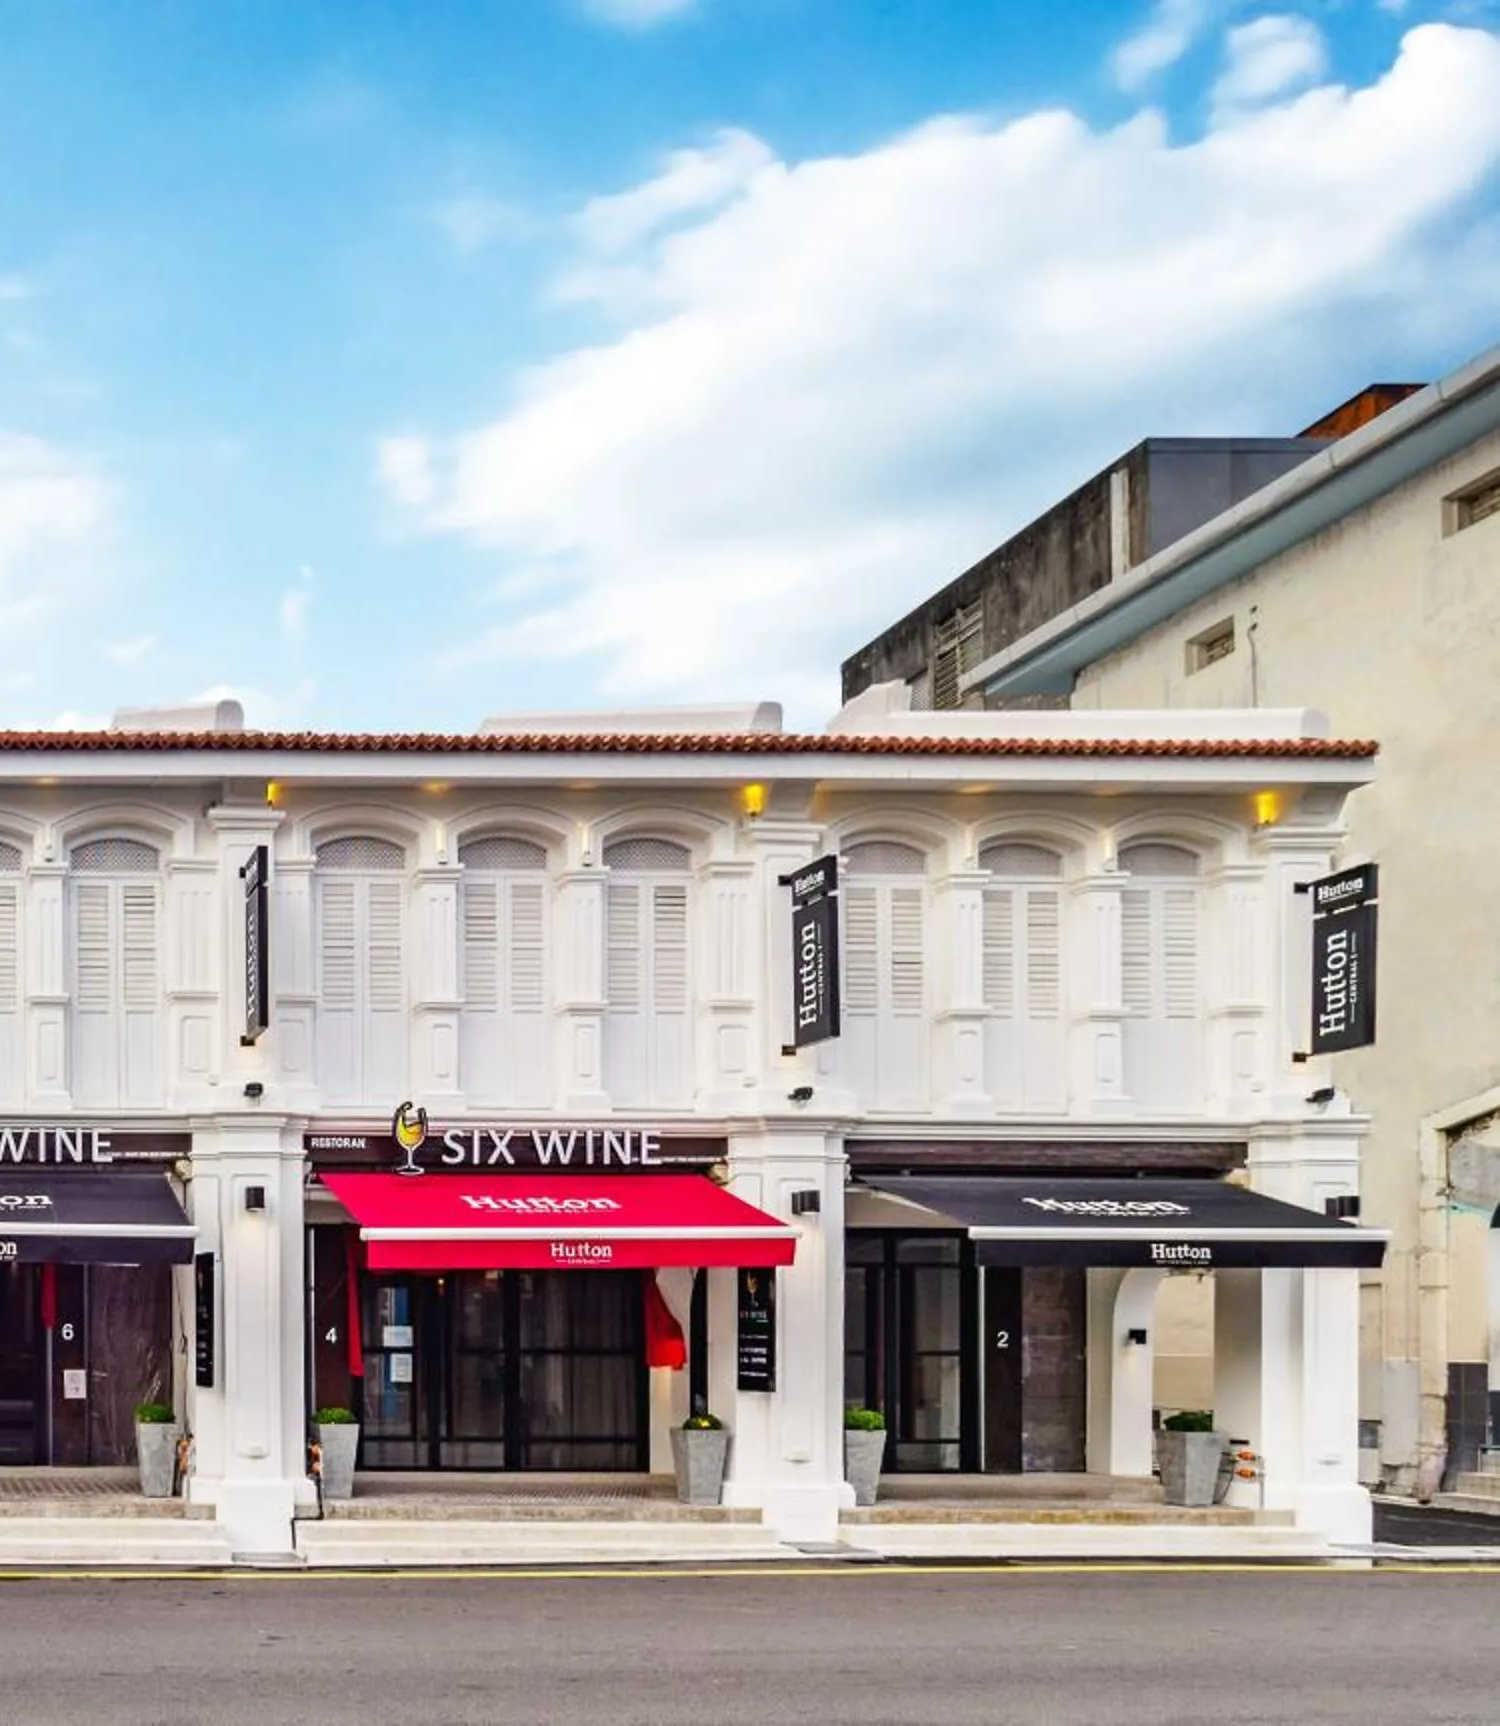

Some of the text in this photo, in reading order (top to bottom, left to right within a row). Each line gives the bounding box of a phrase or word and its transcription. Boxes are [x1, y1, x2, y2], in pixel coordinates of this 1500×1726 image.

[800, 920, 817, 1028] Hutton
[1319, 929, 1348, 1037] Hutton
[311, 1129, 662, 1165] RESTORAN SIX WINE
[460, 1195, 622, 1210] Hutton
[550, 1242, 613, 1258] Hutton
[1151, 1243, 1212, 1260] Hutton
[62, 1323, 74, 1340] 6
[325, 1327, 337, 1344] 4
[997, 1330, 1009, 1349] 2
